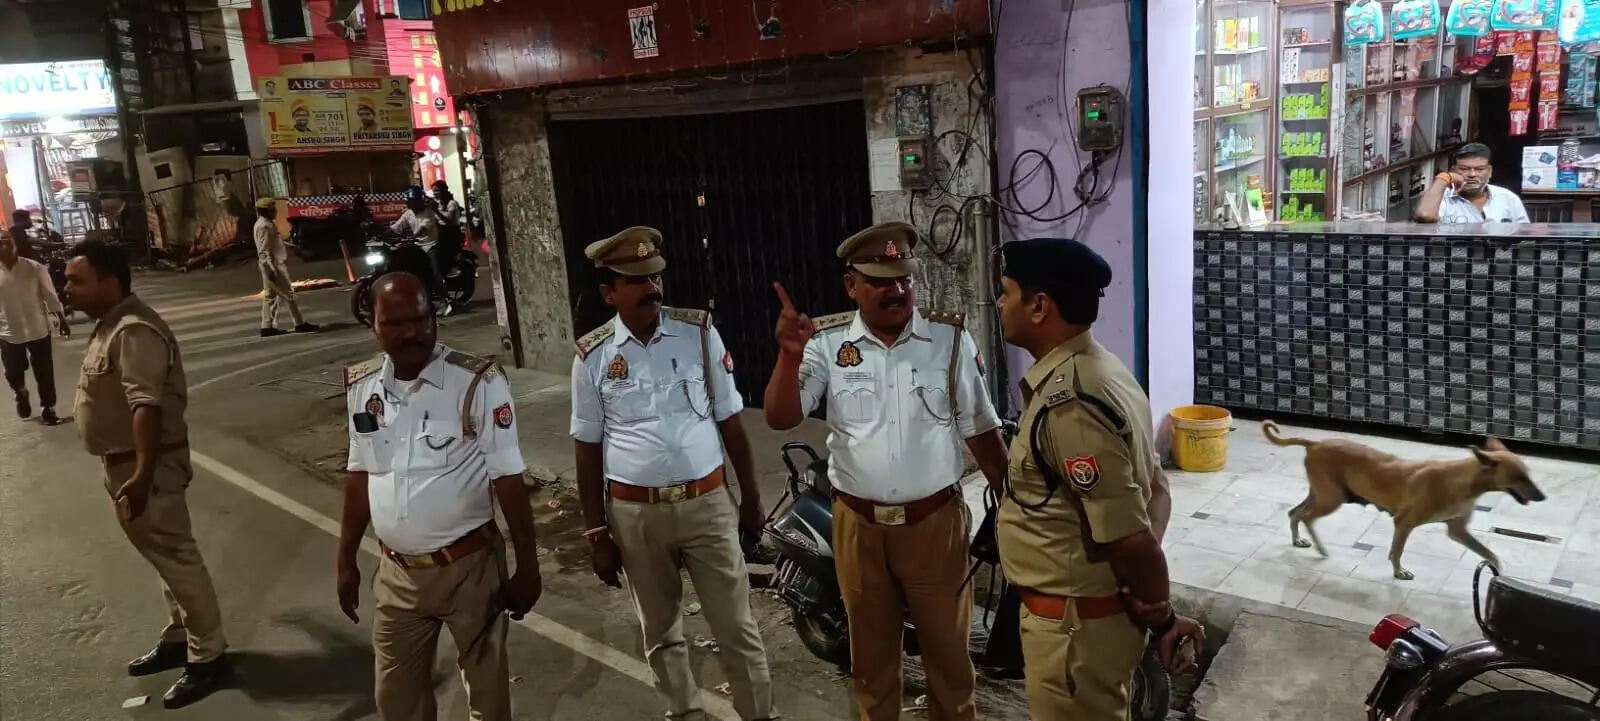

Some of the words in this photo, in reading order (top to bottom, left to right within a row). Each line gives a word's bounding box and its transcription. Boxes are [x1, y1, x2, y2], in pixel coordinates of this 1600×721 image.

[0, 72, 108, 94] NOVELTY
[290, 80, 327, 90] ABC
[328, 79, 380, 89] Classes
